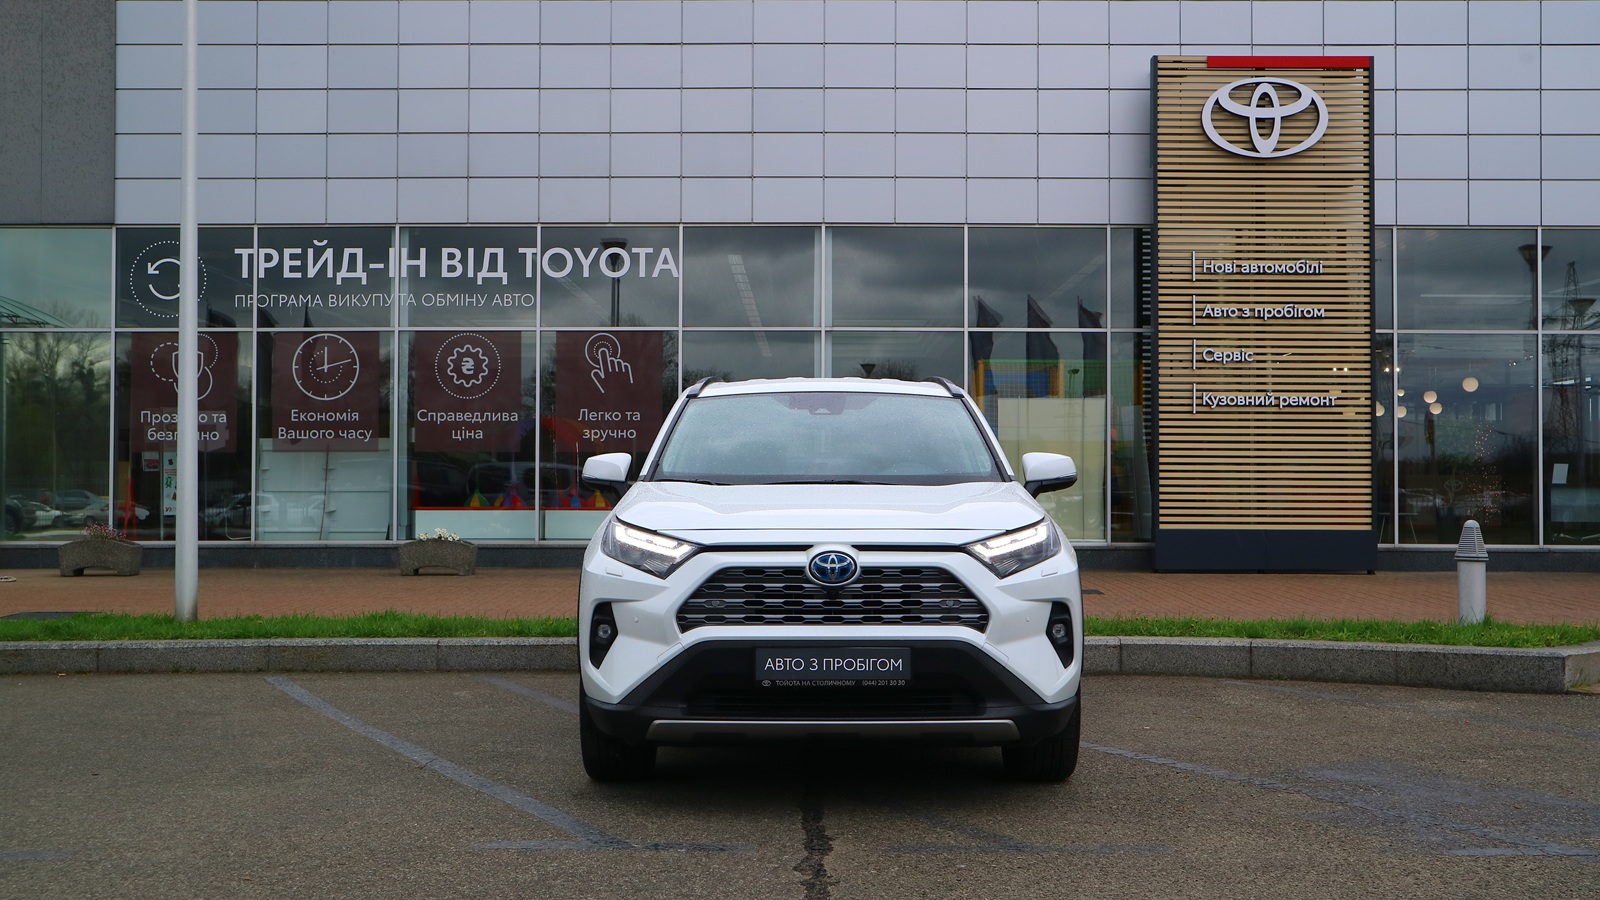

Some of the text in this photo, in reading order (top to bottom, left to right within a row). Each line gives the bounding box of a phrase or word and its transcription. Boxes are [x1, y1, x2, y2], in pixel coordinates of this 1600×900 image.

[234, 239, 679, 285] ТРЕЙД-ІН ВІД TOYOTA
[1202, 260, 1324, 274] Нові автомобілі
[235, 293, 535, 308] ПРОГРАМА ВИКУПУ ТА ОБМІНУ АВТО
[1202, 303, 1326, 321] Авто з пробігом
[1202, 348, 1254, 364] Сервіс
[1202, 391, 1338, 410] Кузовний ремонт
[140, 410, 227, 426] Прозо та
[291, 410, 359, 423] Економія
[417, 409, 518, 423] Справедлива
[578, 409, 641, 422] Легко та
[147, 427, 220, 441] безно
[278, 427, 373, 442] Вашого часу
[452, 427, 483, 440] ціна
[583, 427, 637, 441] зручно
[764, 658, 903, 671] АВТО З ПРОБІГОМ
